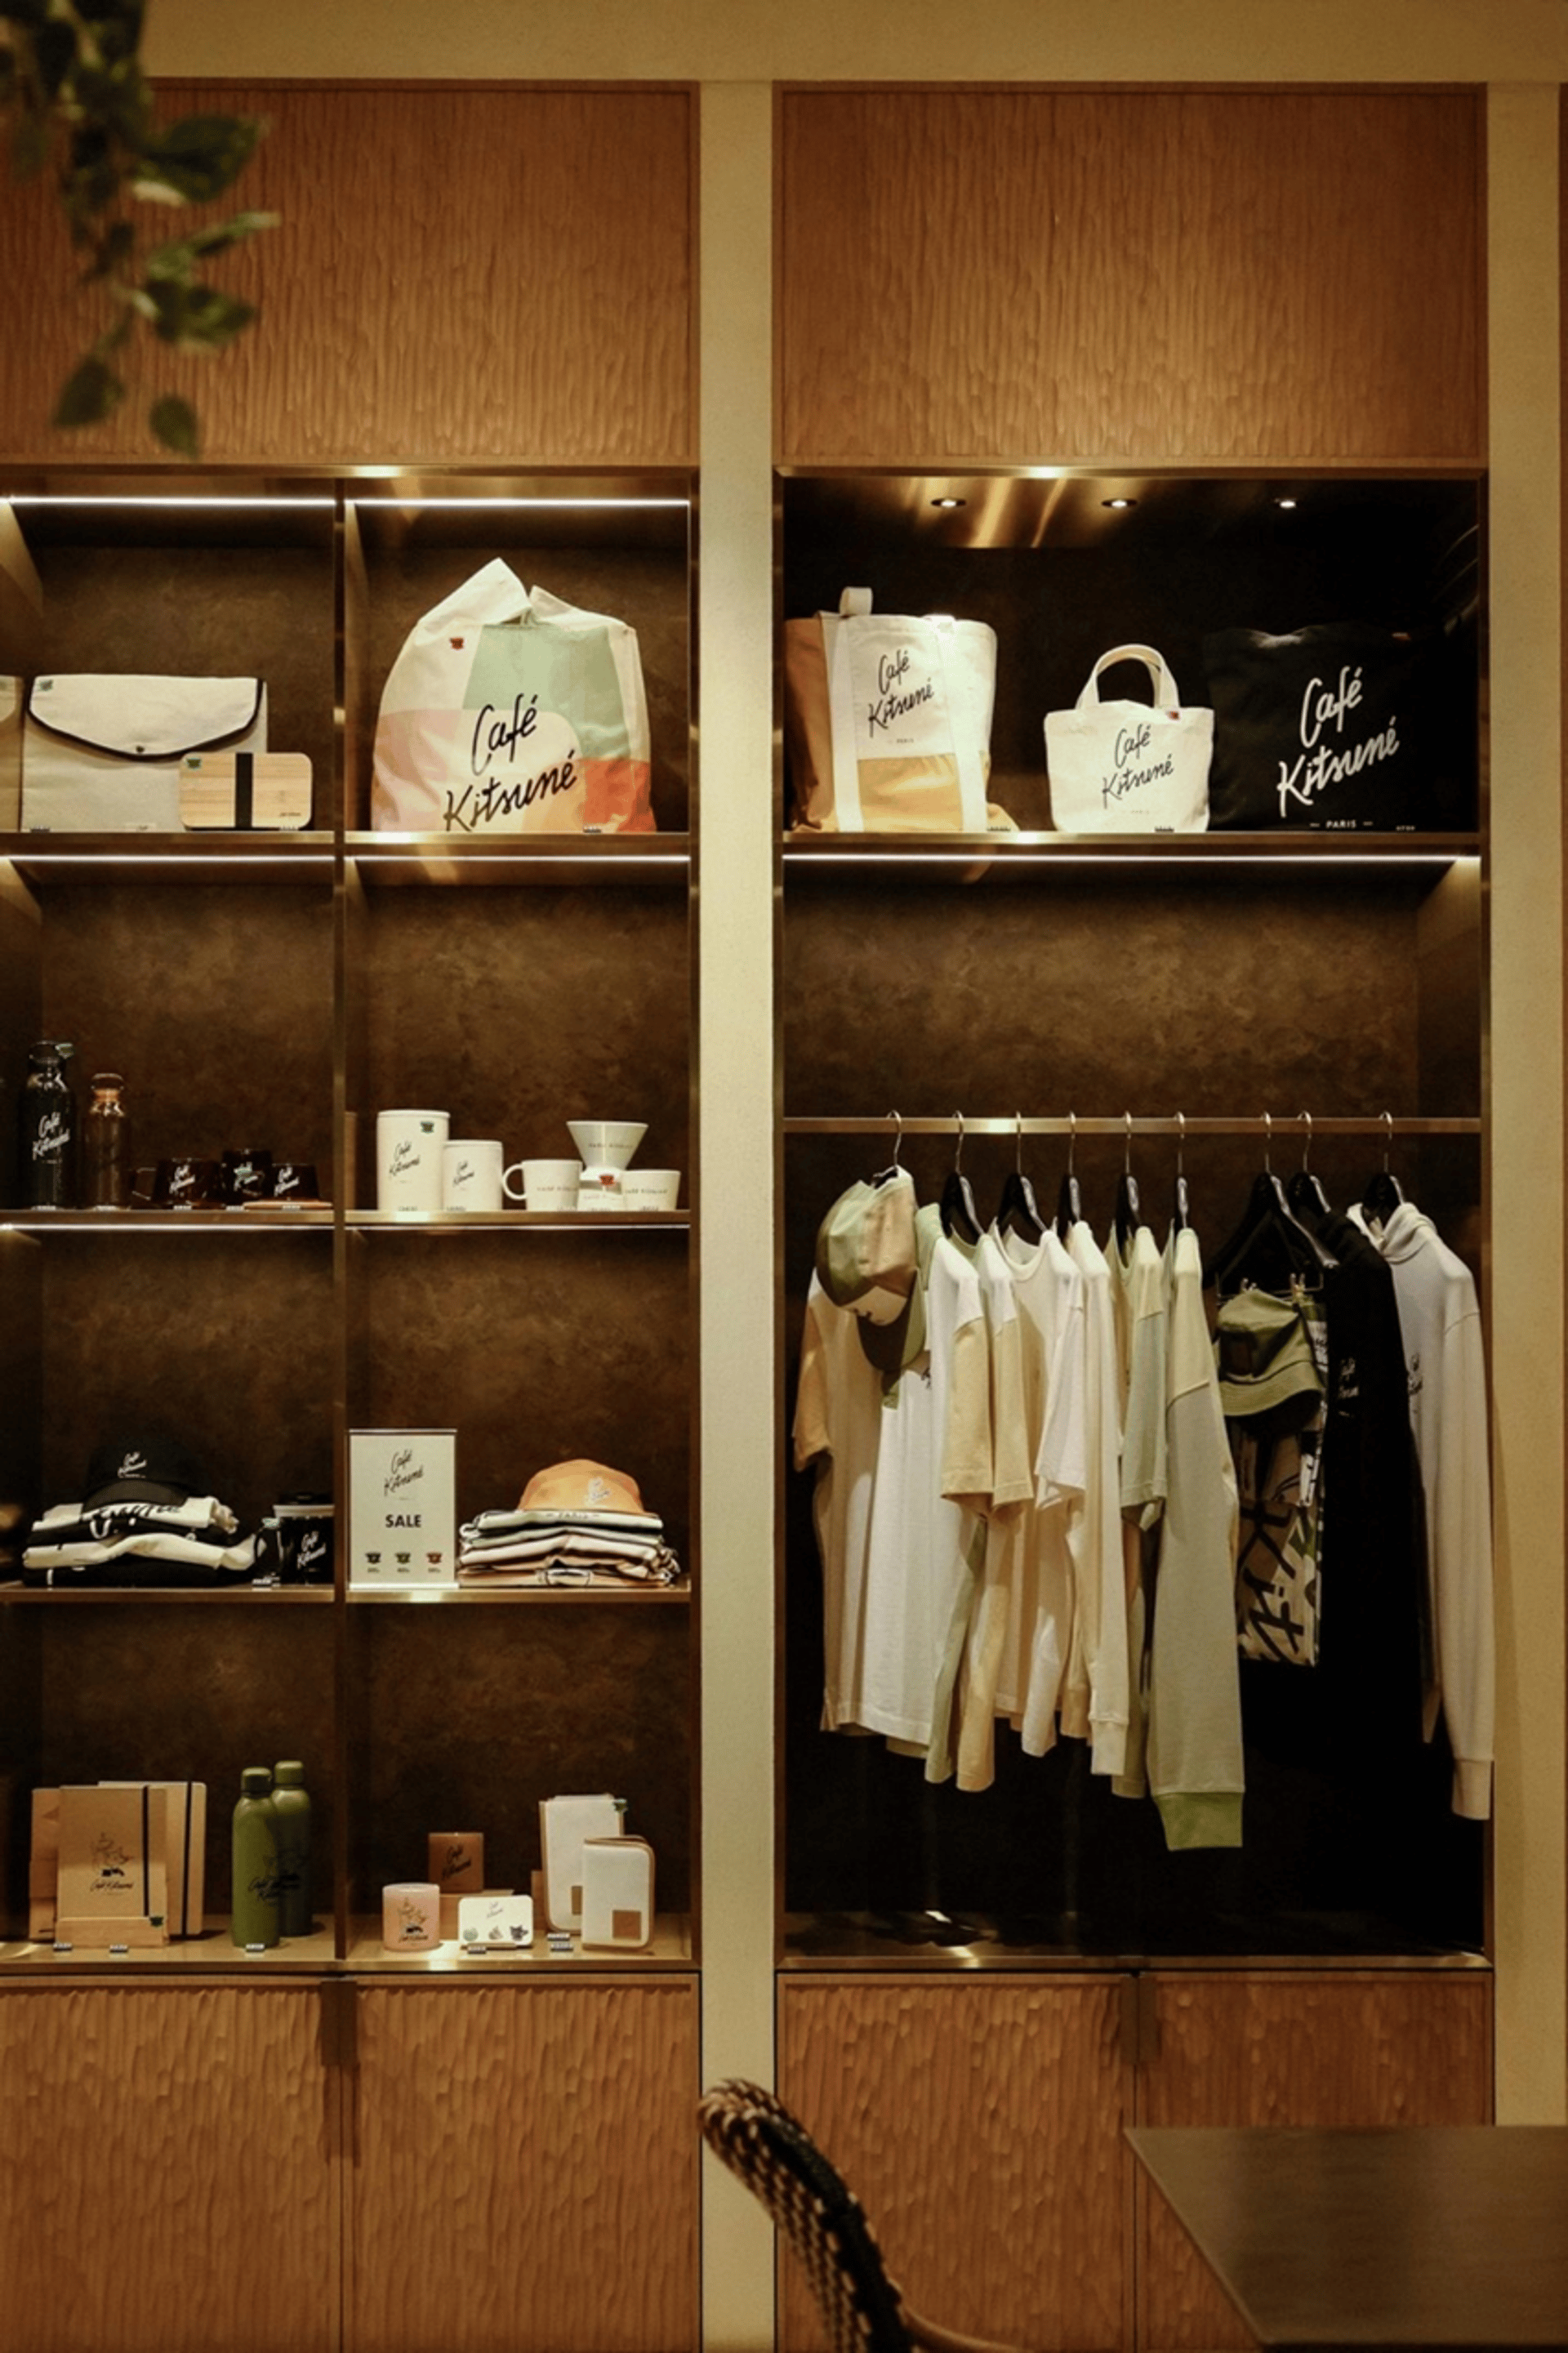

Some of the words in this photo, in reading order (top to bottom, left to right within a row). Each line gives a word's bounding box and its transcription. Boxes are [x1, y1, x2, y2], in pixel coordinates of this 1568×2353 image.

[878, 649, 911, 695] Café
[471, 693, 538, 776] Café
[868, 677, 934, 738] Kitsuné
[1299, 666, 1363, 749] Café
[1114, 724, 1152, 769] Café
[1276, 715, 1401, 818] Kitsuné
[443, 749, 577, 832] Kitsuné
[1102, 753, 1174, 809] Kitsuné
[1325, 819, 1357, 829] PARIS
[385, 1514, 421, 1528] SALE
